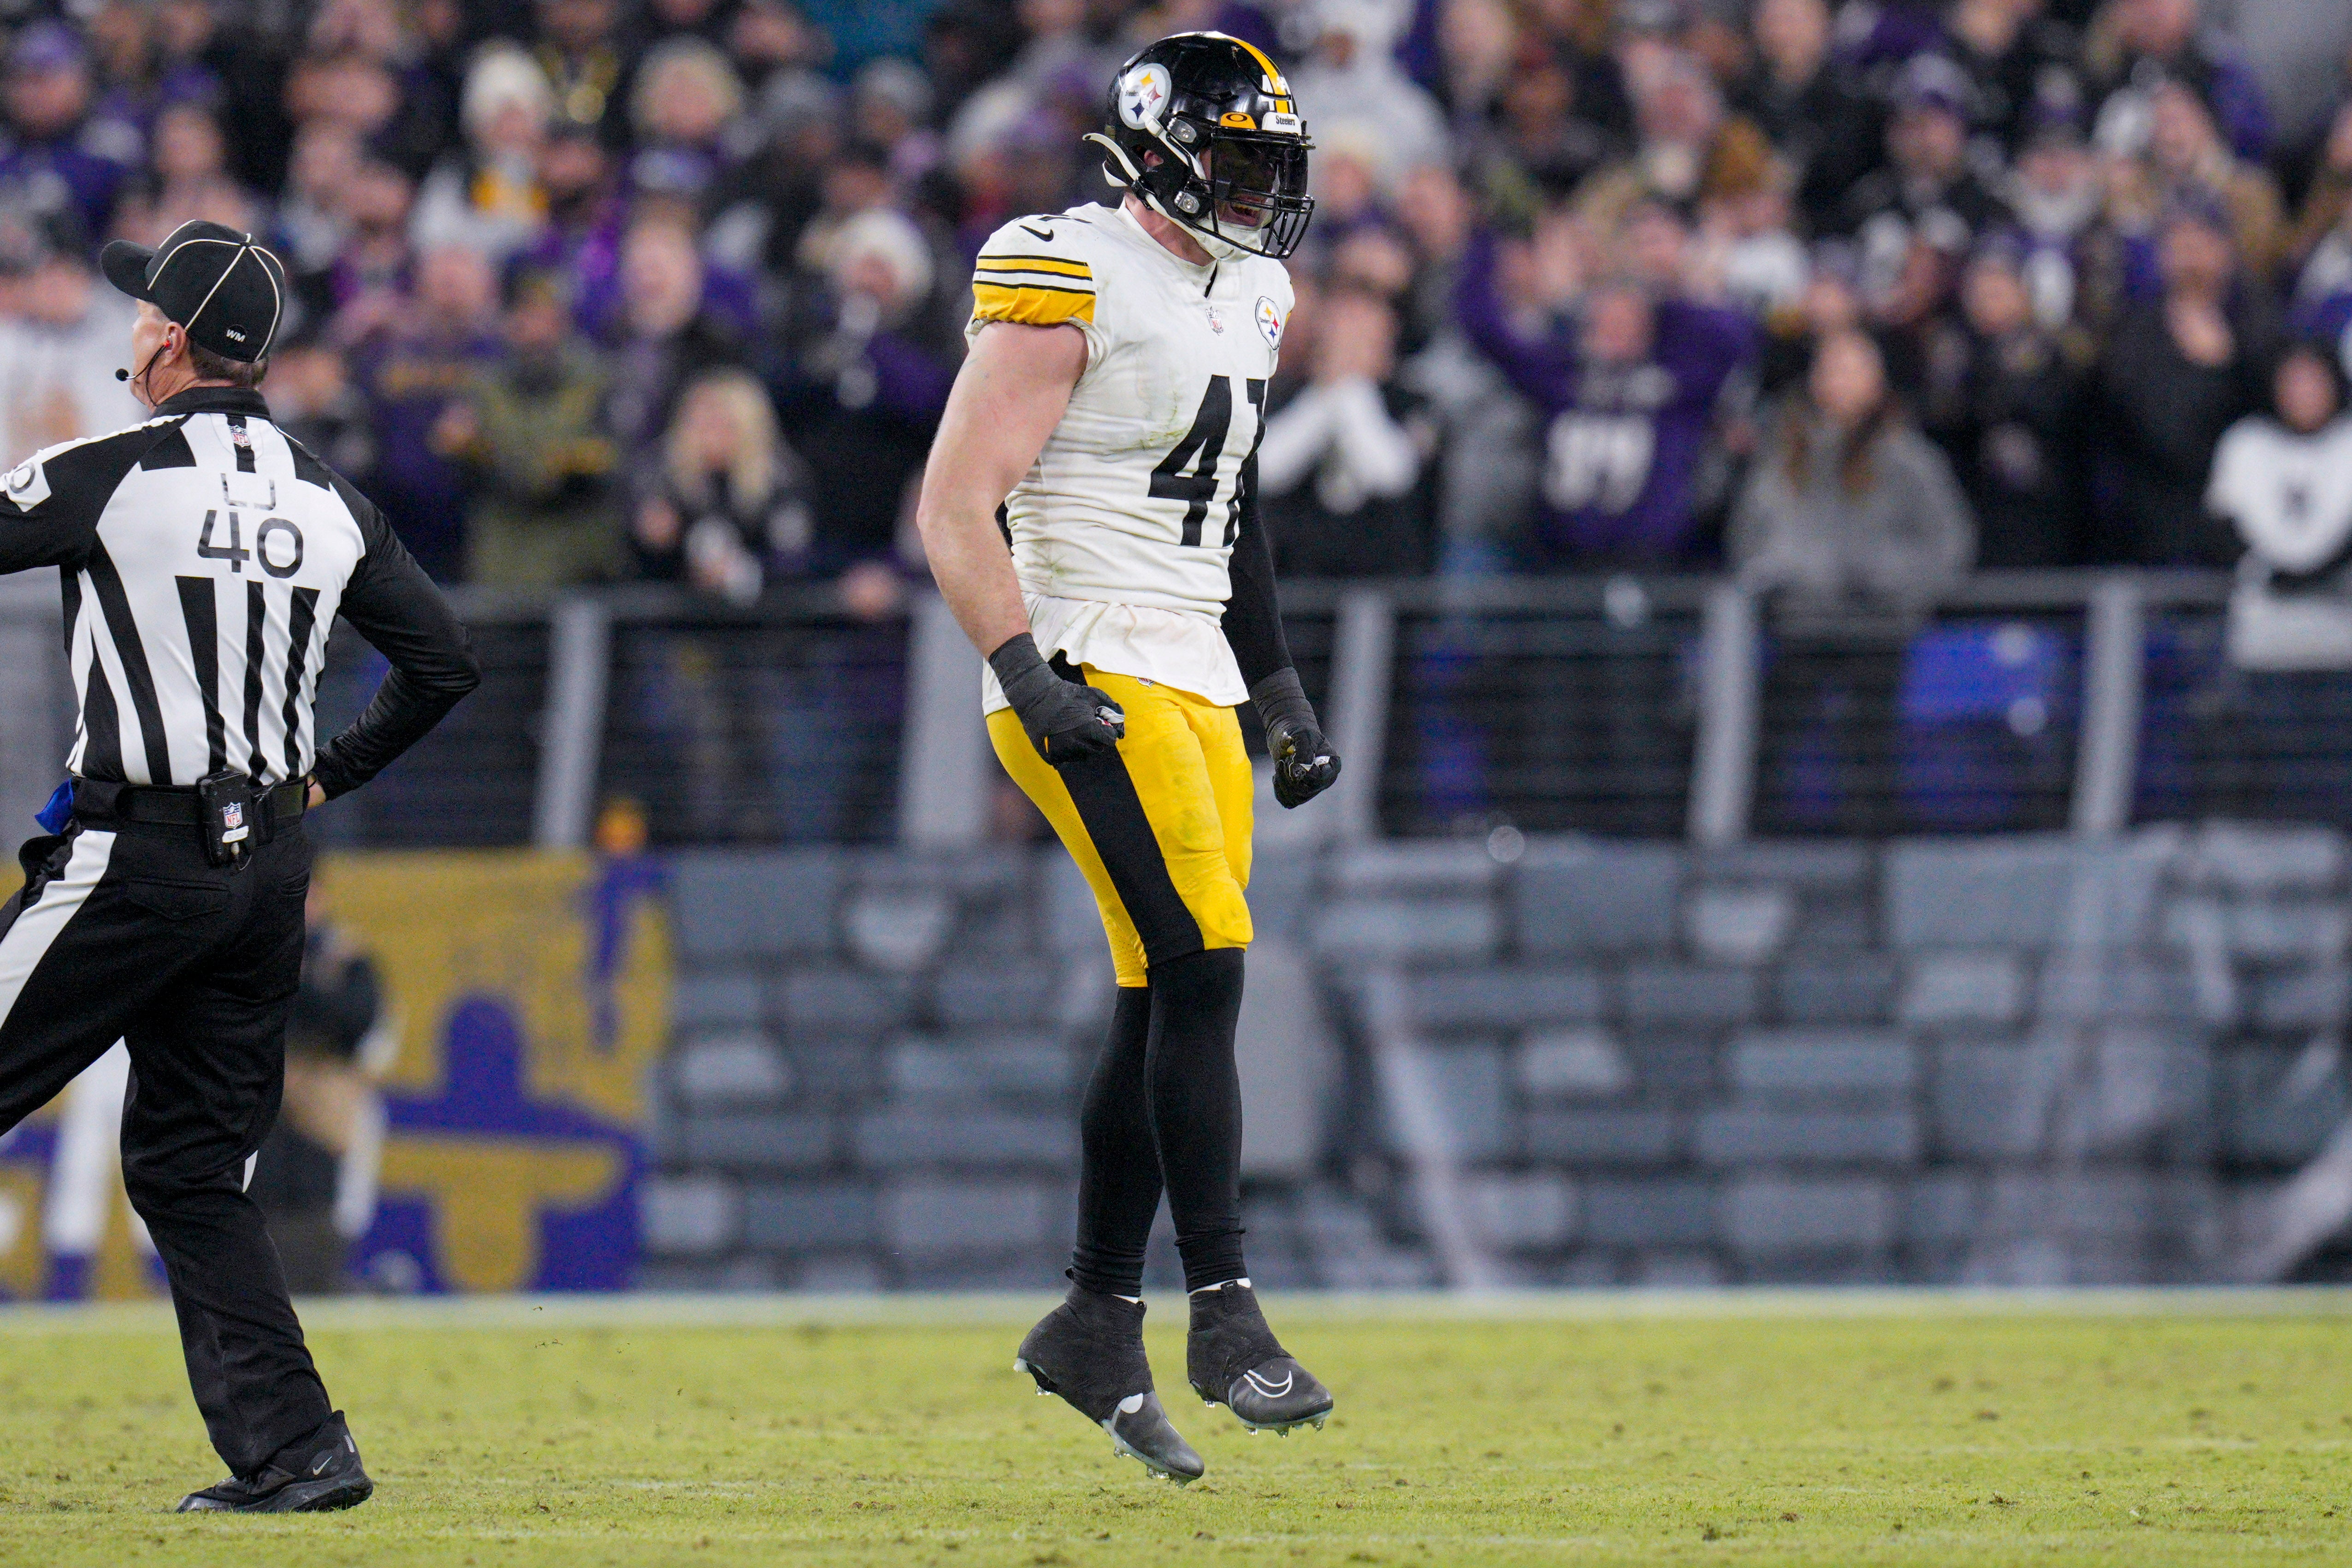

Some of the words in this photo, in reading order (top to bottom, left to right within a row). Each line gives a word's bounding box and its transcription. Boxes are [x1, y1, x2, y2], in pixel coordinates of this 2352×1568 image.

[1276, 115, 1295, 126] Steelers
[226, 329, 246, 342] WM
[233, 433, 249, 444] NFL
[198, 509, 303, 579] 40
[226, 814, 240, 825] NFL
